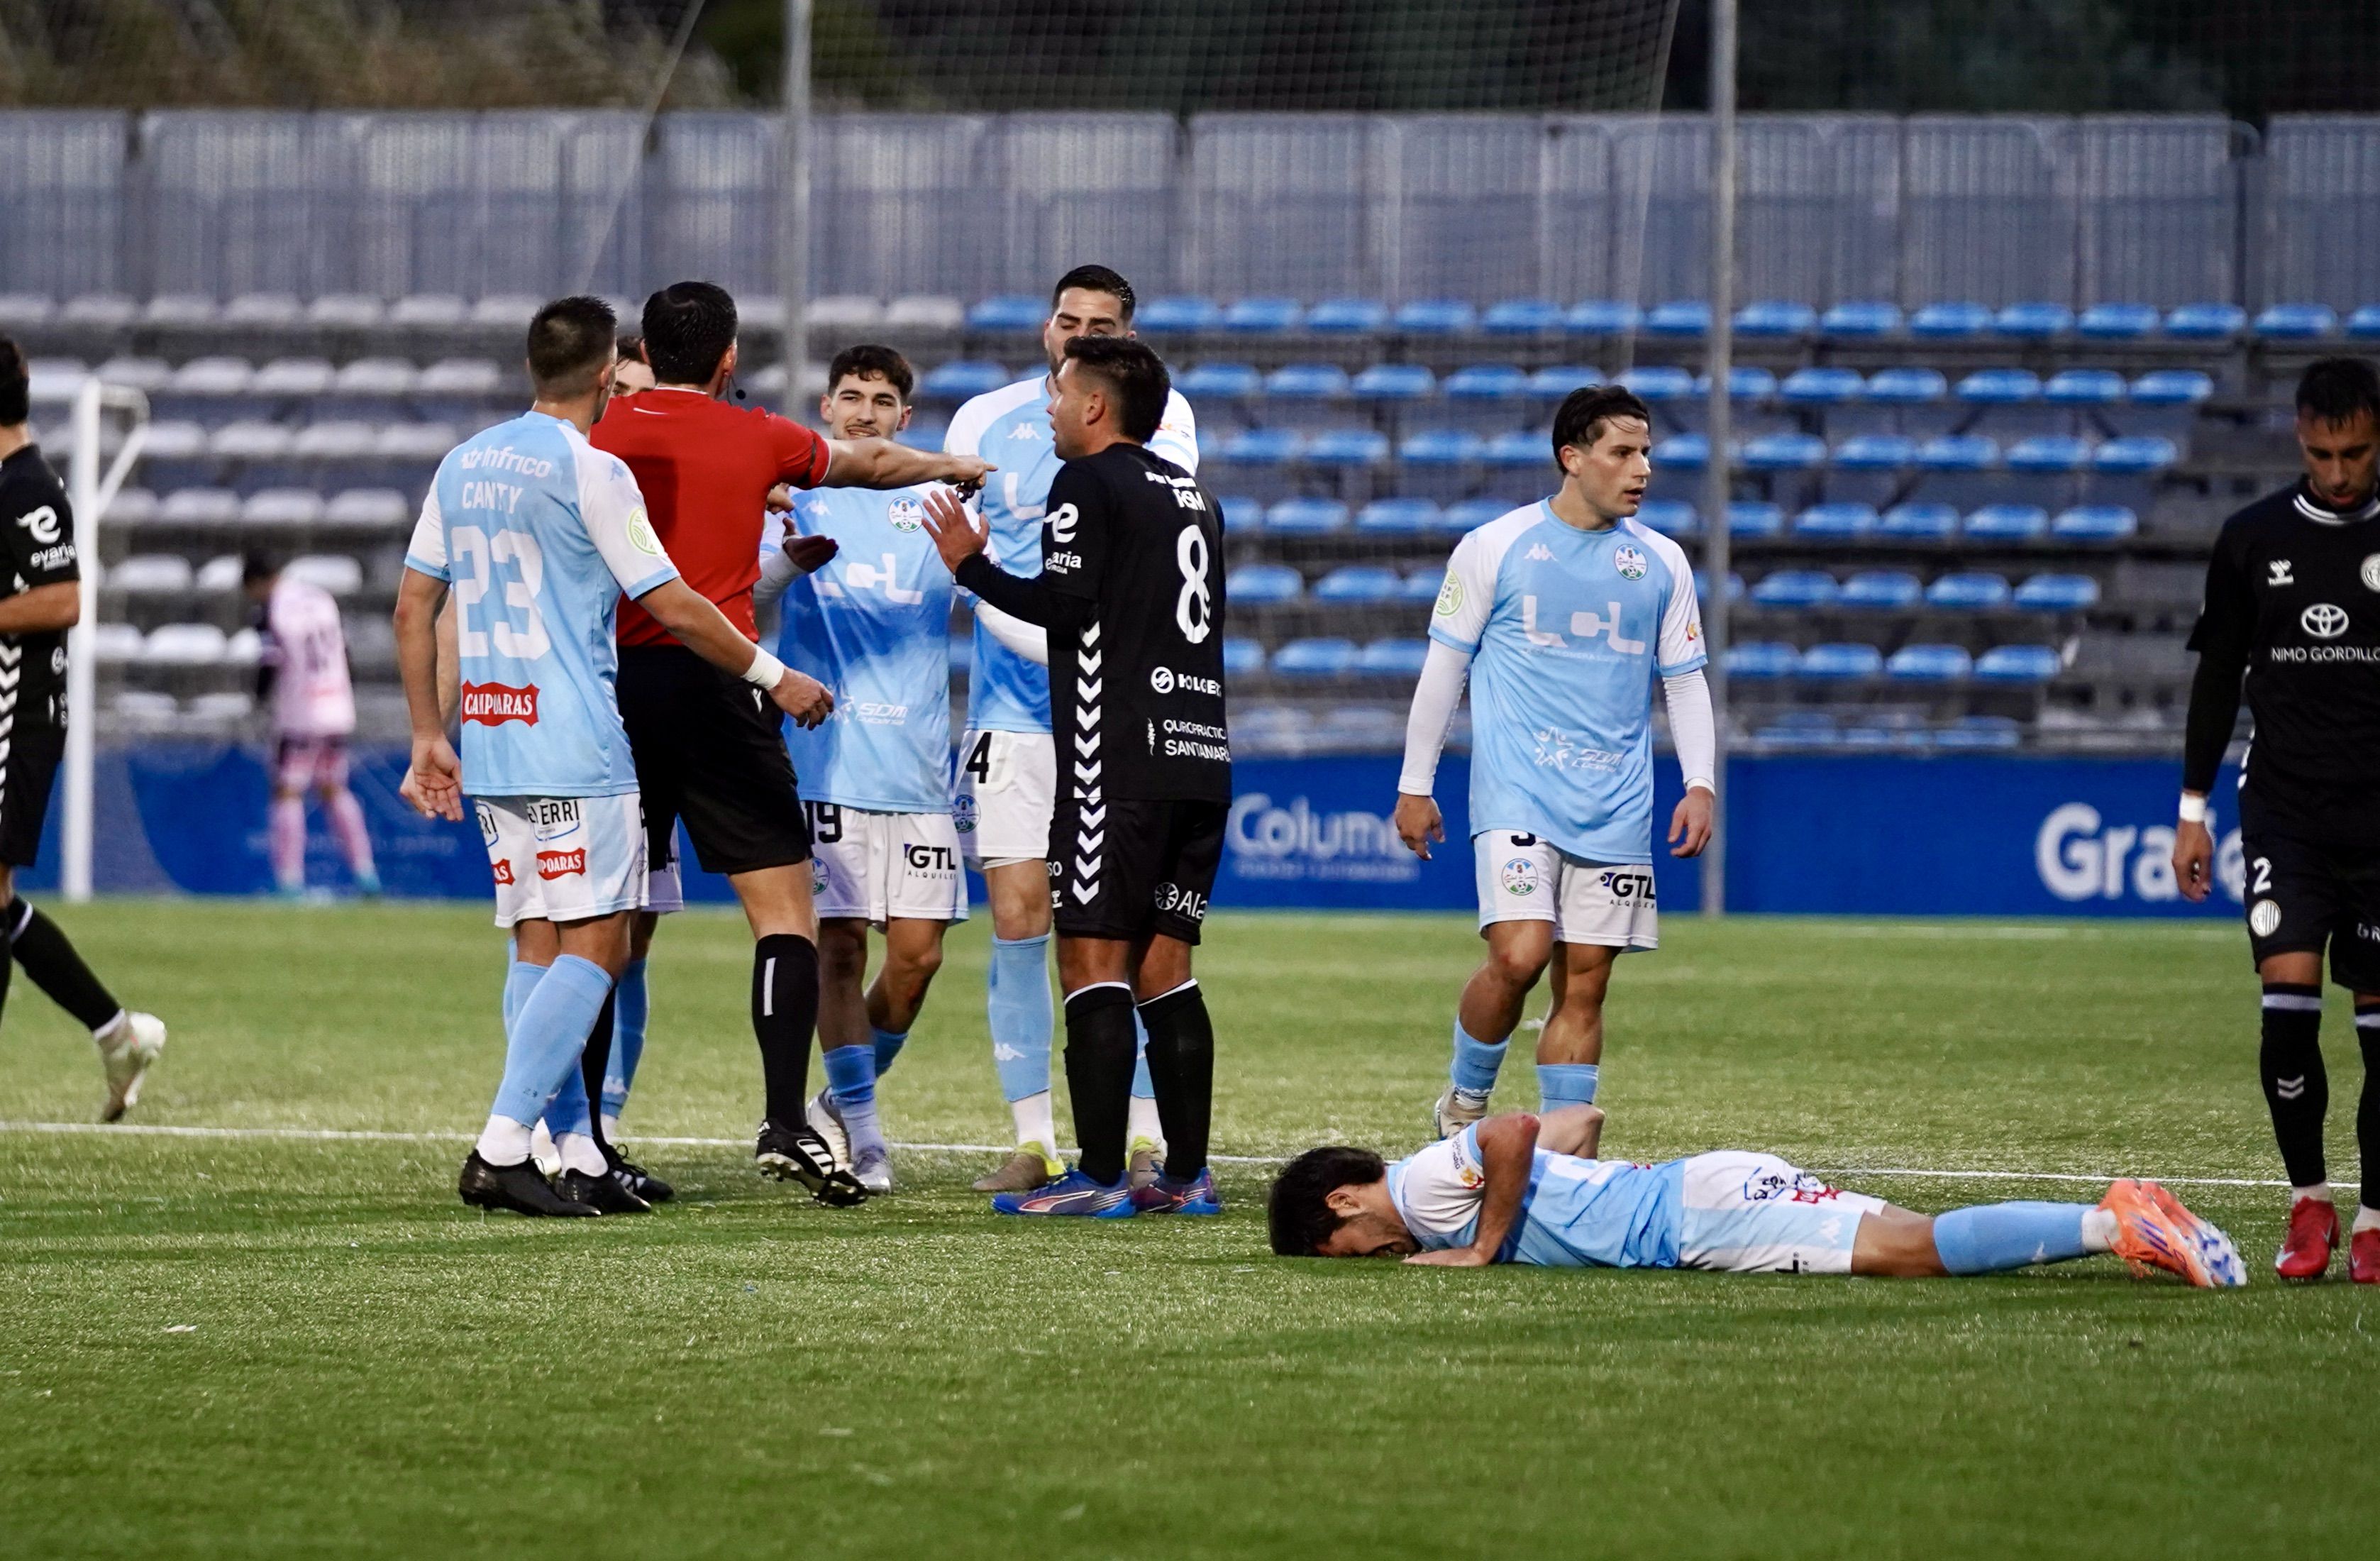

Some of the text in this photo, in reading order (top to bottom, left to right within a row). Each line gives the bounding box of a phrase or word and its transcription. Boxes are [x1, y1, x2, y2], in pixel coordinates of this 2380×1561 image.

[463, 480, 524, 514] CANTY
[451, 525, 551, 661] 23
[1176, 524, 1211, 644] 8
[2271, 646, 2307, 663] NIMO
[966, 732, 992, 784] 4
[805, 800, 843, 845] 19
[909, 845, 956, 871] GTL
[2251, 856, 2272, 895] 2
[1612, 873, 1656, 900] GTL
